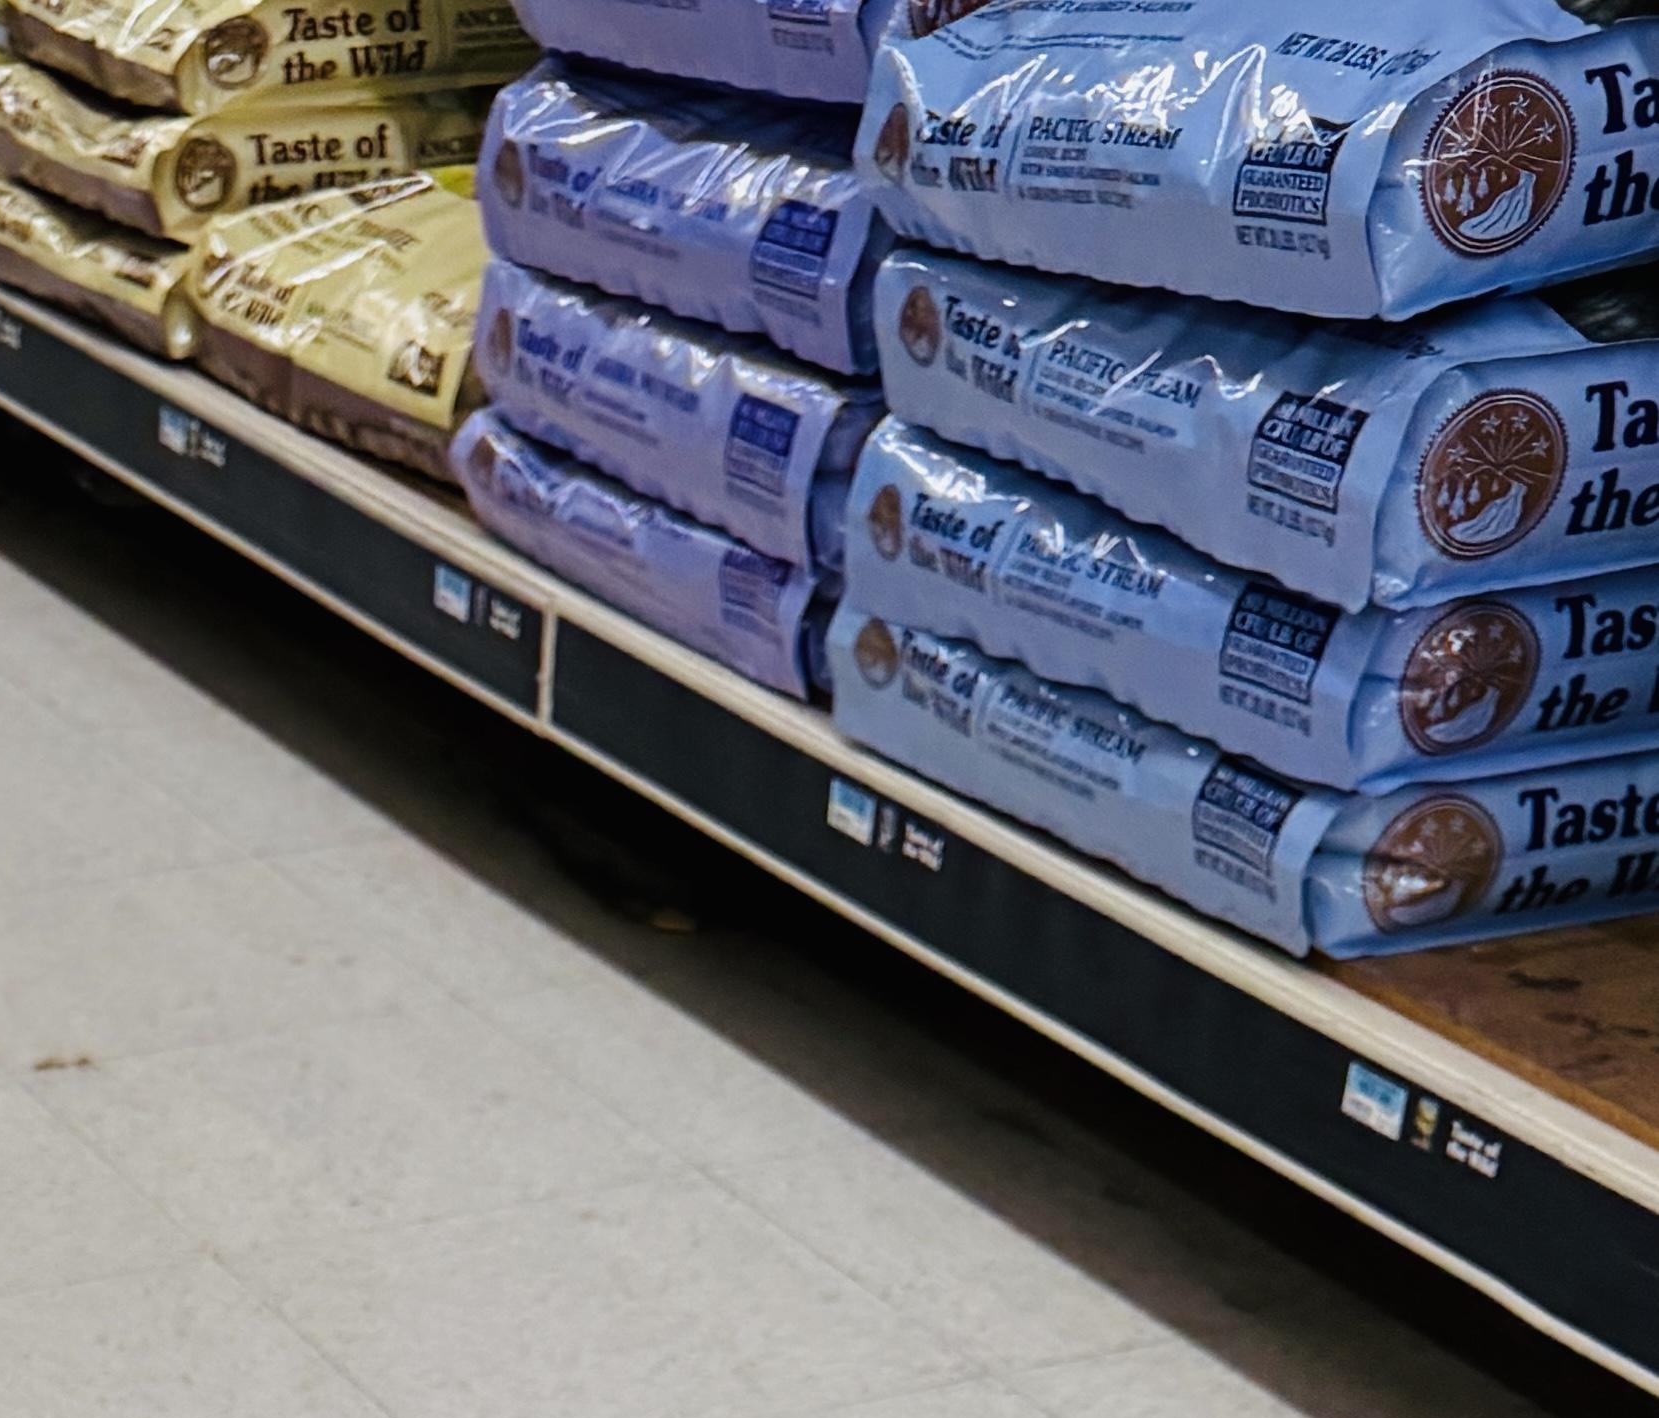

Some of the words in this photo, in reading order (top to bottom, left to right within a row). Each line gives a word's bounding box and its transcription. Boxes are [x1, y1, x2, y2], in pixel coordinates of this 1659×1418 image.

[283, 8, 375, 41] Taste
[386, 0, 422, 32] of
[283, 52, 337, 84] the
[350, 40, 428, 77] Wild
[246, 133, 344, 165] Taste
[356, 123, 388, 159] of
[1534, 673, 1630, 732] the
